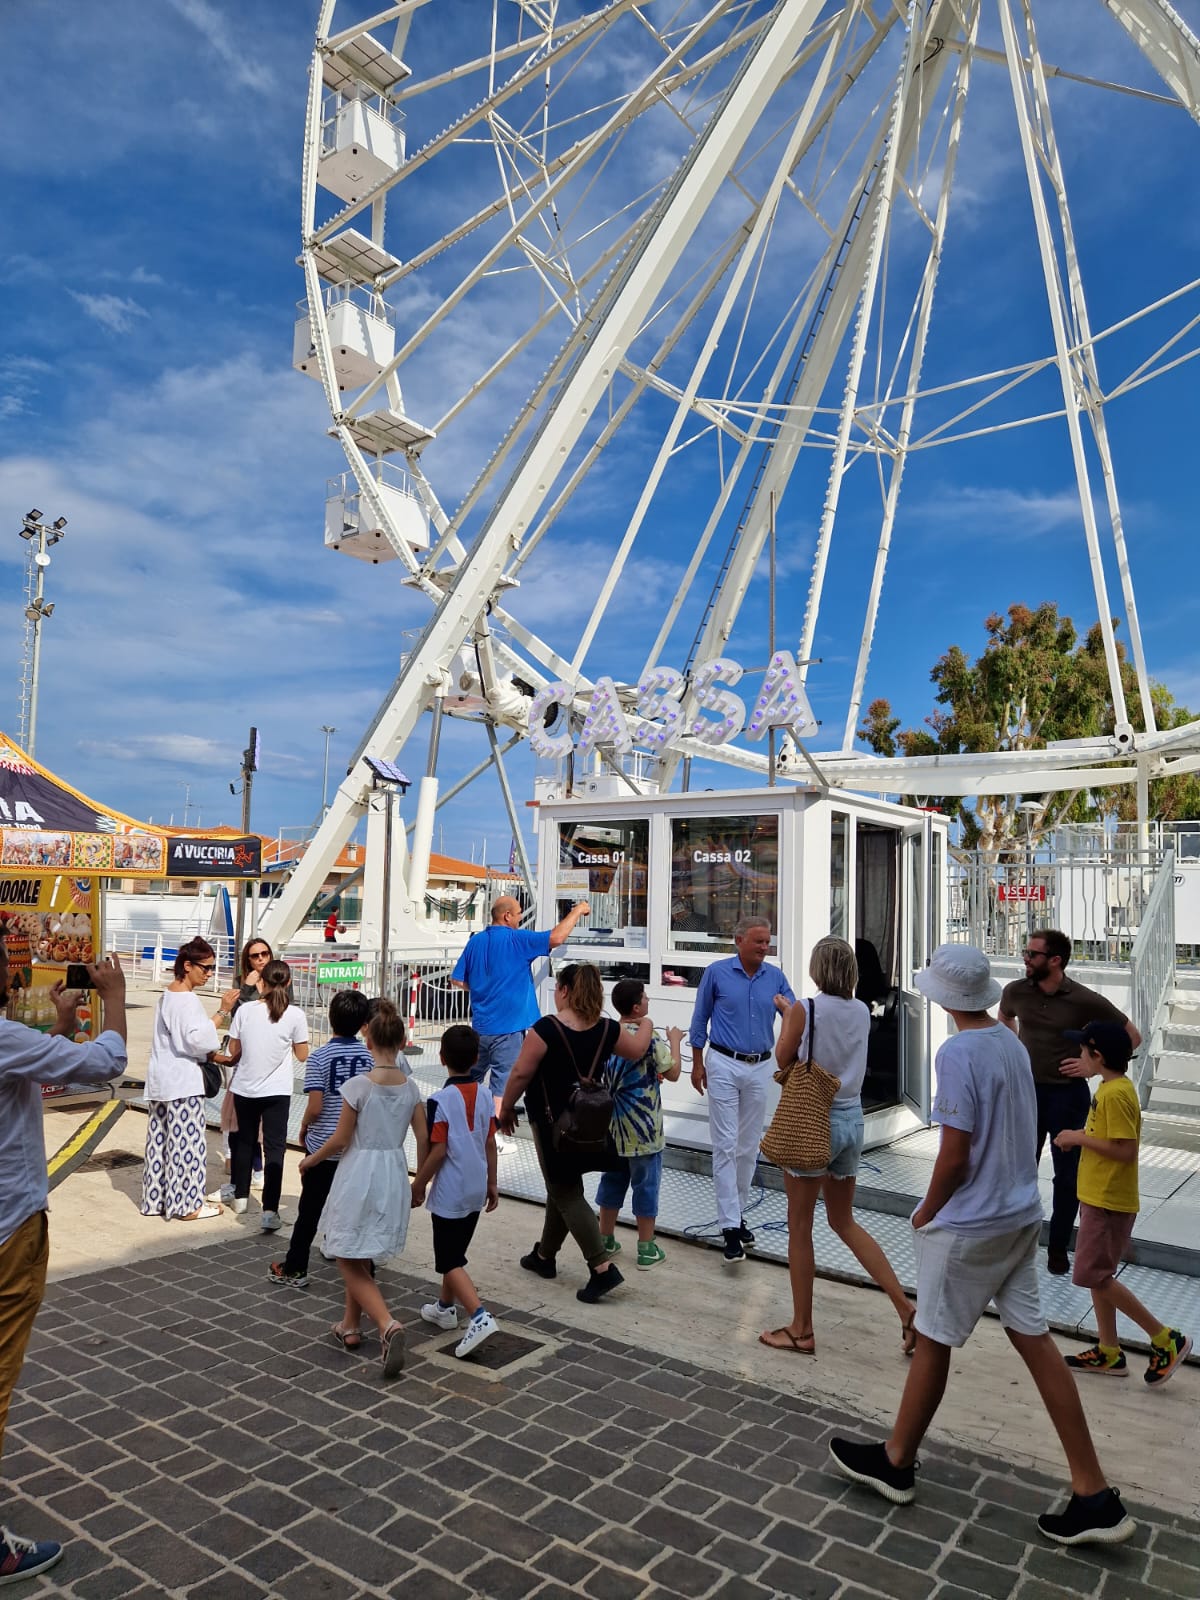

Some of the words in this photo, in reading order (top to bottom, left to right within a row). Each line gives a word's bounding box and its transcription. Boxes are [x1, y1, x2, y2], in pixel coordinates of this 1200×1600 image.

[527, 650, 819, 758] CASSA
[578, 852, 610, 864] Cassa
[613, 851, 625, 863] 01
[693, 850, 731, 863] Cassa
[734, 849, 751, 863] 02
[1003, 886, 1040, 896] USCITA
[319, 966, 364, 979] ENTRATA
